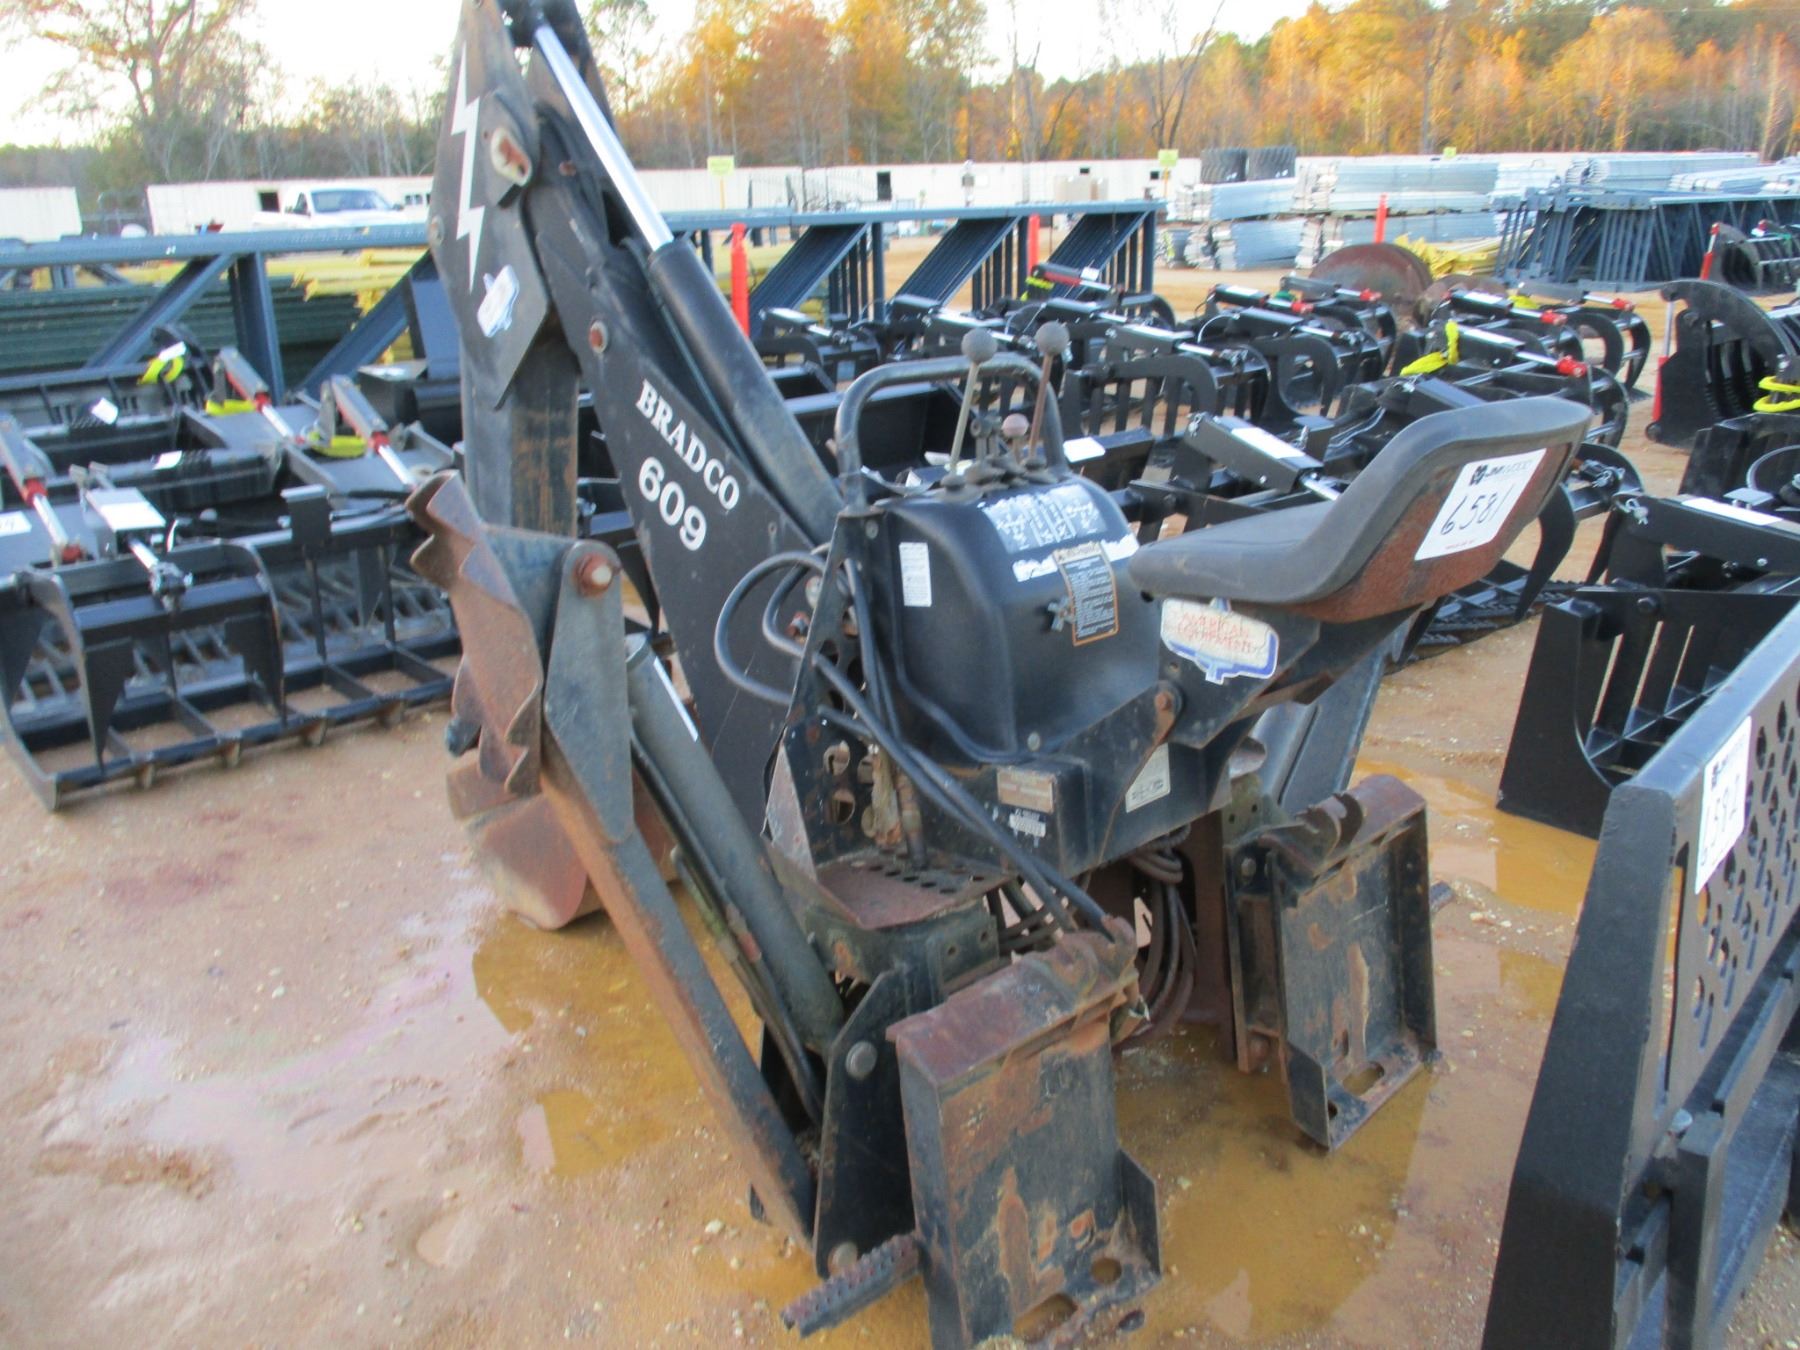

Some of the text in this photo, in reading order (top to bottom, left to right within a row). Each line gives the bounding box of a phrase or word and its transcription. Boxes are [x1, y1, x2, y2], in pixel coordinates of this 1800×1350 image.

[635, 379, 739, 511] BRADCO
[638, 456, 707, 551] 609
[1441, 483, 1515, 535] 6581
